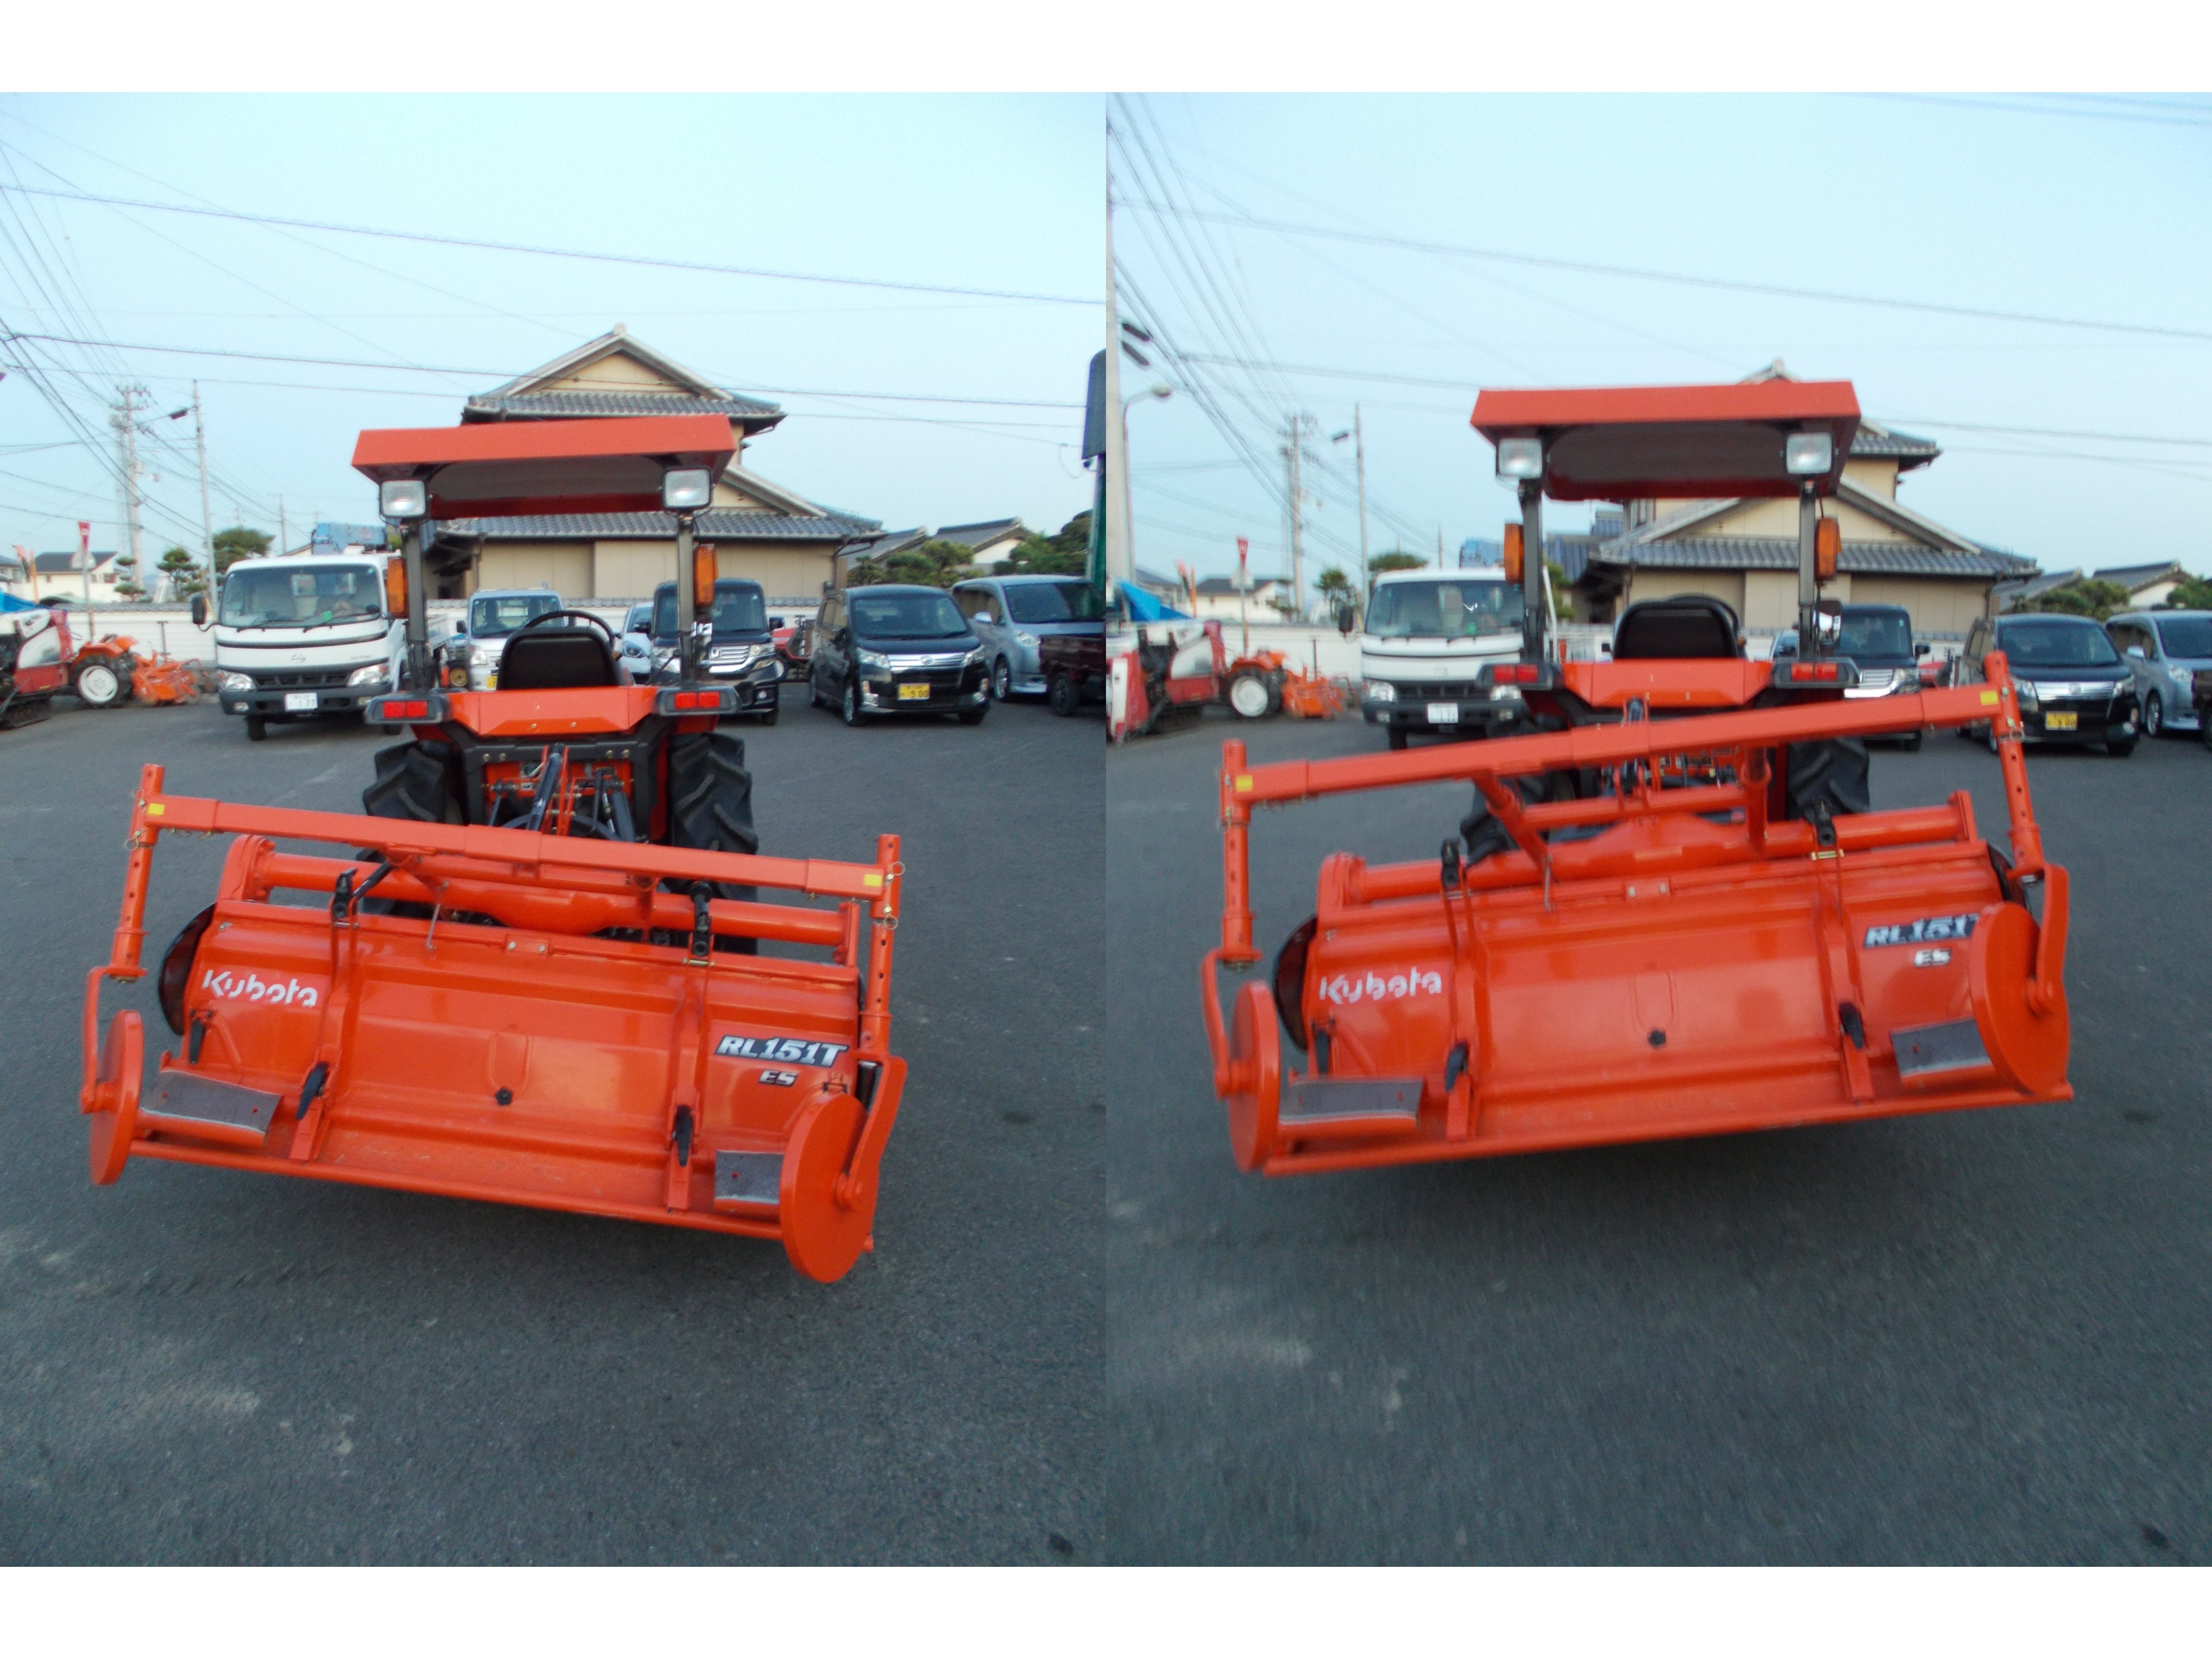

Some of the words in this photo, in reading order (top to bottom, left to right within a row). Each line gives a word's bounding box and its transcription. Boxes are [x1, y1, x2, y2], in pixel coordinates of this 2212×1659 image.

[1914, 949, 1951, 967] ES
[202, 969, 318, 1007] Kubota
[1319, 966, 1442, 1005] Kubota
[715, 1035, 849, 1067] RL151T
[759, 1069, 799, 1087] ES
